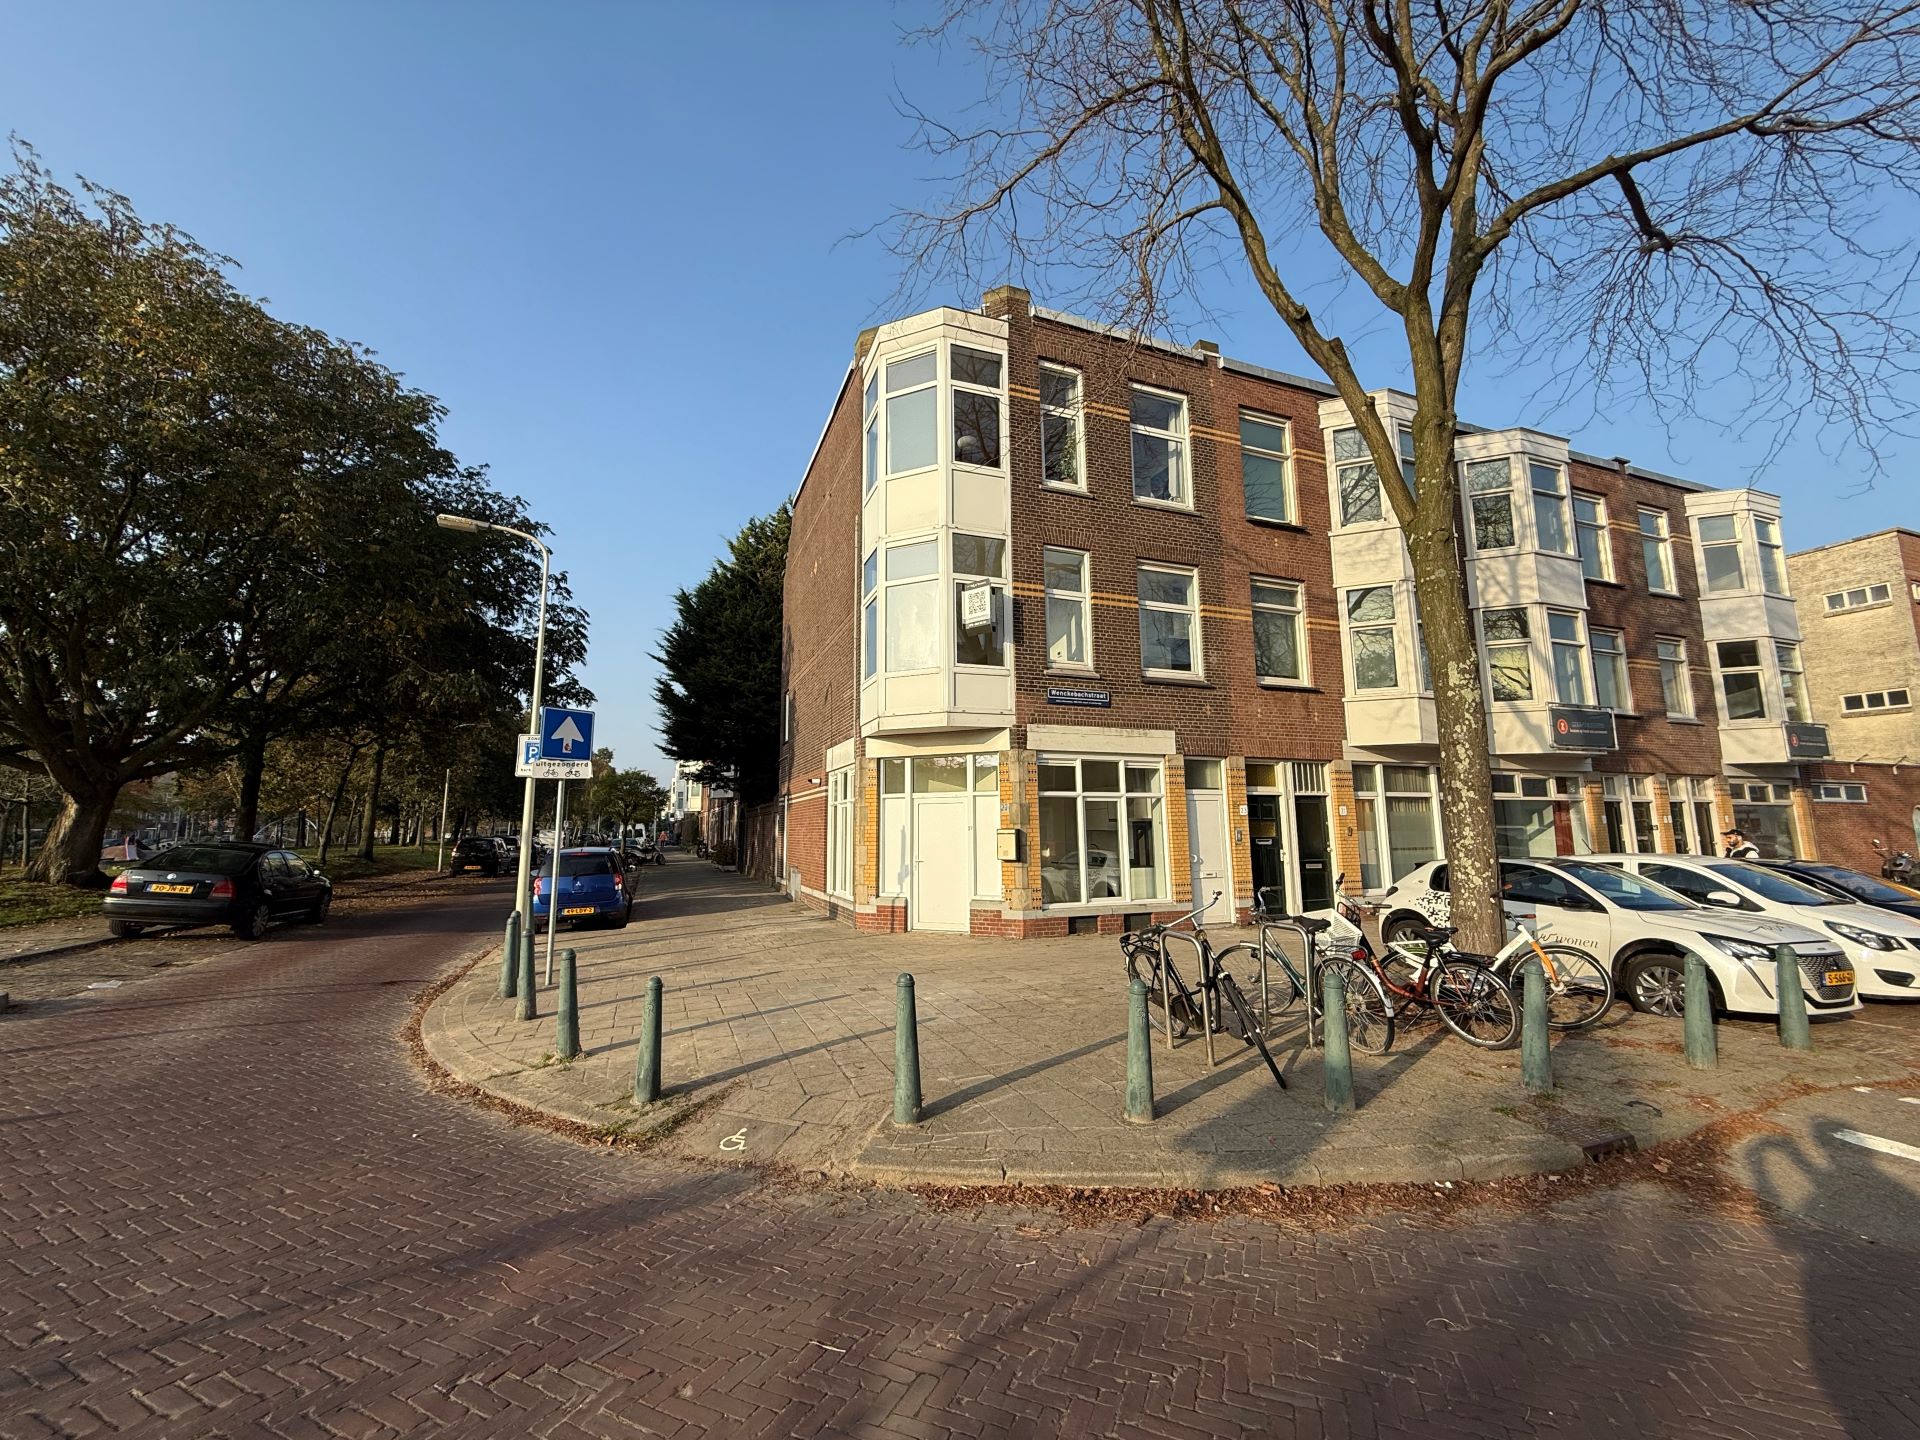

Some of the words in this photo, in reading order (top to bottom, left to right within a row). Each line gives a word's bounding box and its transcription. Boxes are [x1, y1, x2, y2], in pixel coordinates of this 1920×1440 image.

[1050, 689, 1107, 699] Wenckebachstraat
[529, 747, 538, 758] P
[535, 761, 589, 769] uitgezonderd
[1556, 934, 1600, 949] wonen
